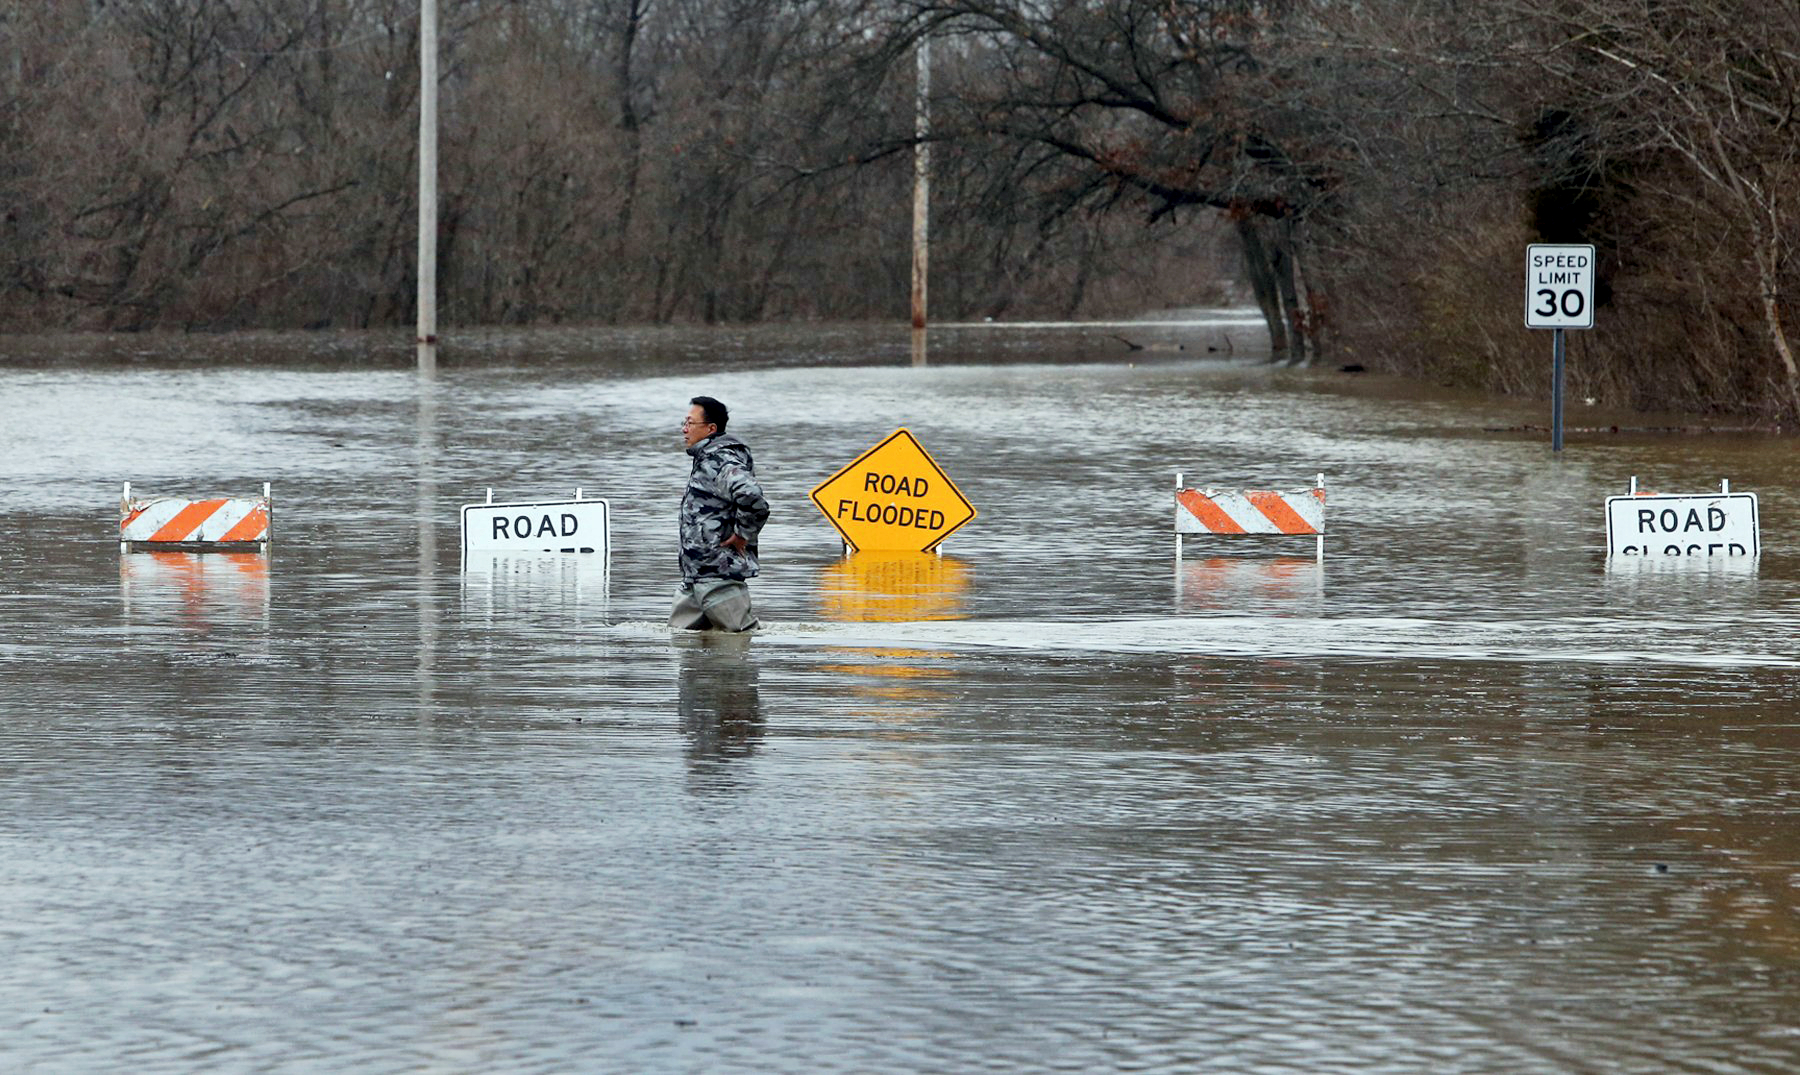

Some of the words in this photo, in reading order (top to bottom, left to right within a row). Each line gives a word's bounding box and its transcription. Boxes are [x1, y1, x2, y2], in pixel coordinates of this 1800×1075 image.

[1534, 256, 1588, 268] SPEED
[1539, 272, 1581, 284] LIMIT
[1535, 289, 1585, 317] 30
[864, 472, 928, 498] ROAD
[492, 513, 578, 540] ROAD
[837, 499, 945, 530] FLOODED
[1638, 507, 1726, 533] ROAD
